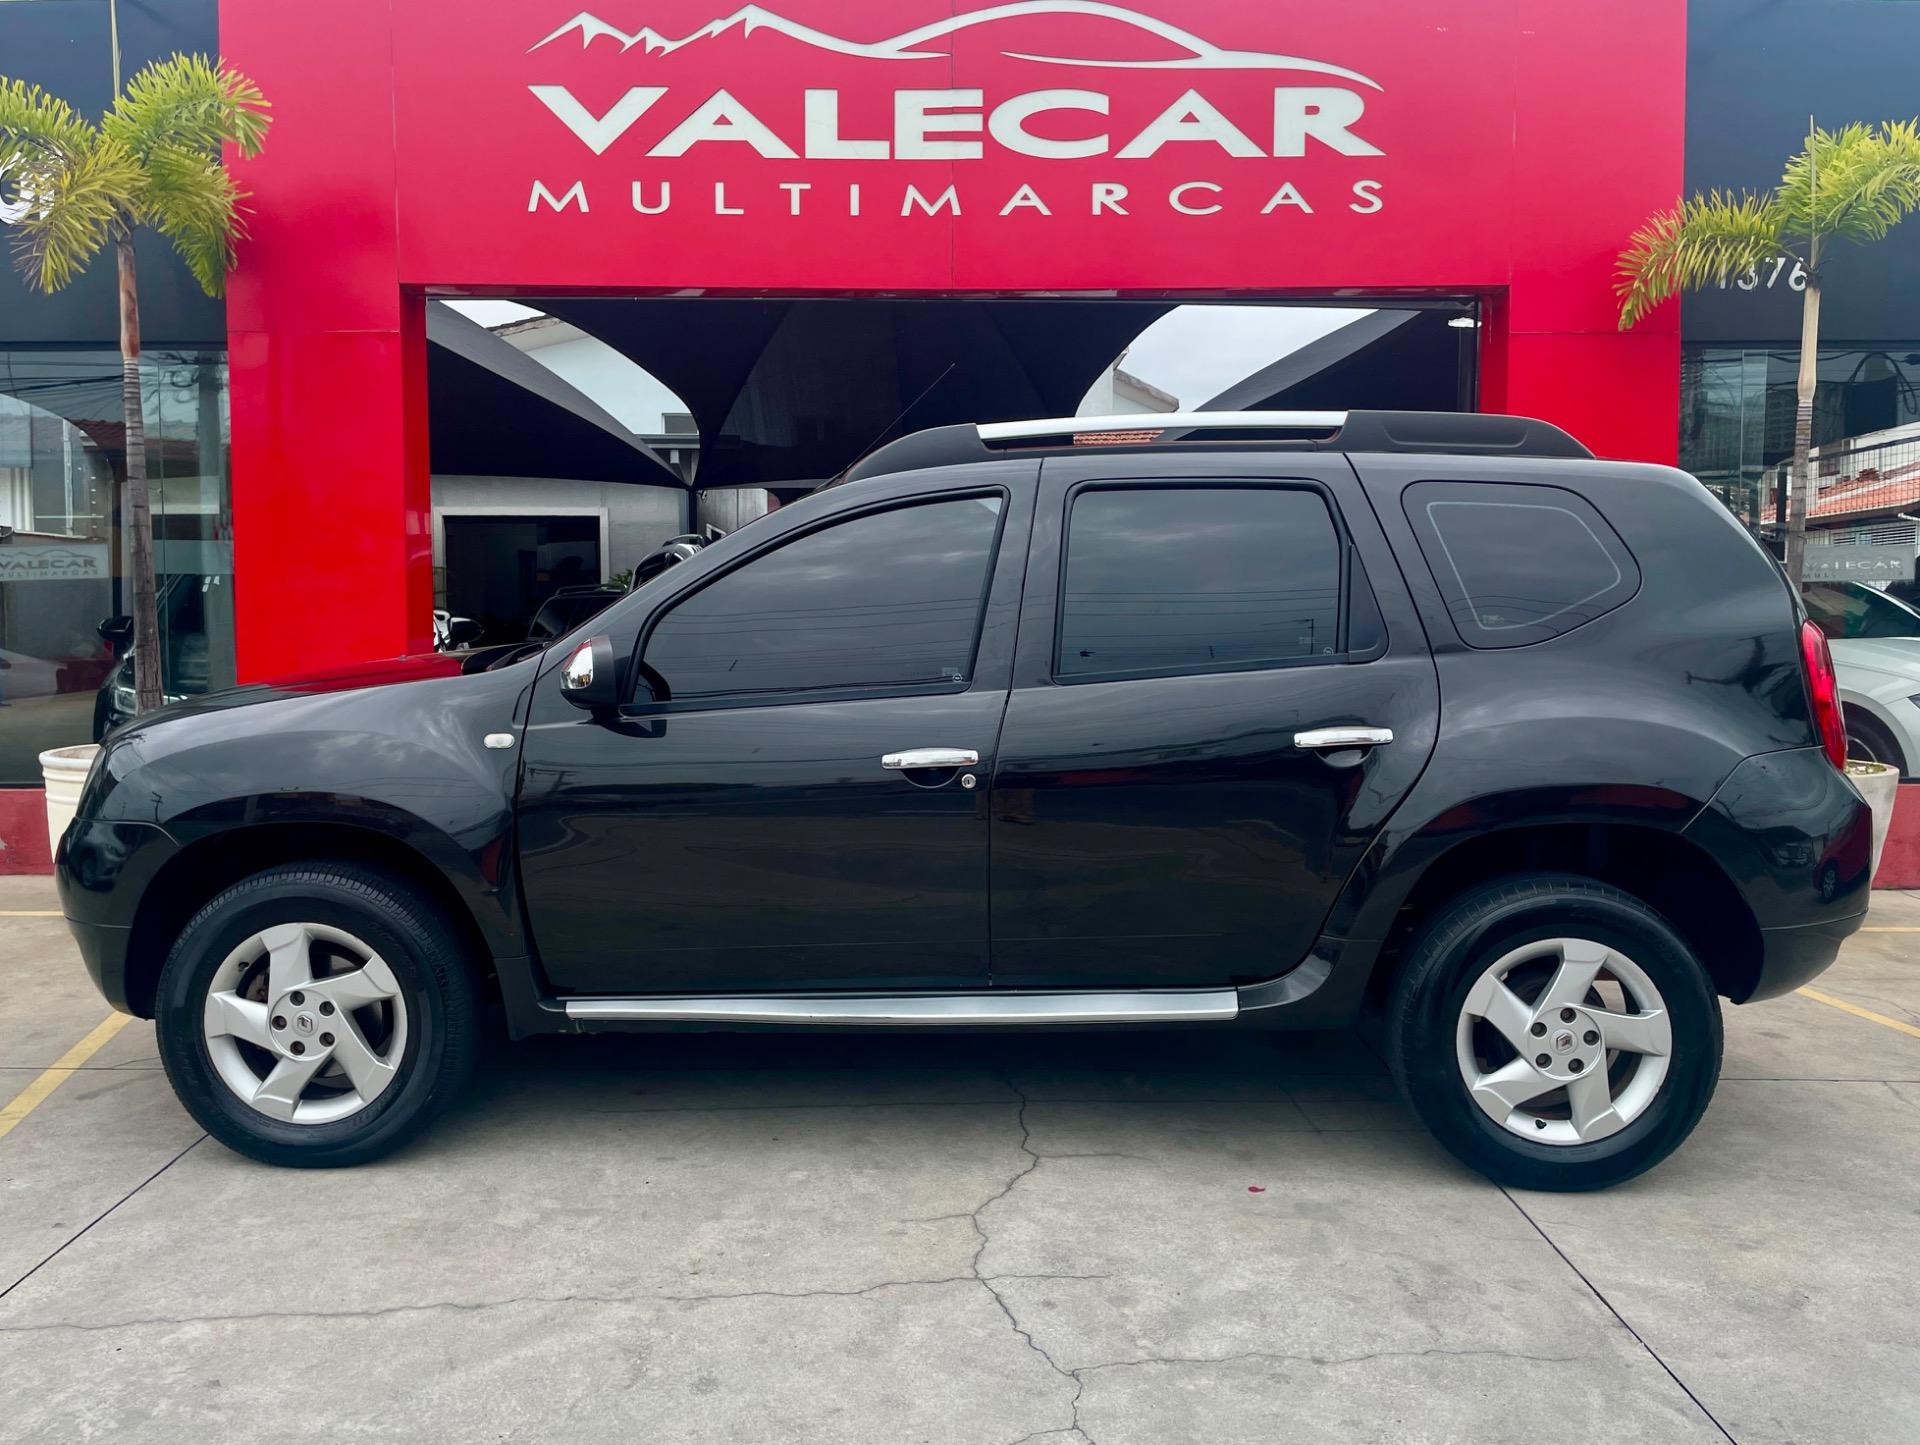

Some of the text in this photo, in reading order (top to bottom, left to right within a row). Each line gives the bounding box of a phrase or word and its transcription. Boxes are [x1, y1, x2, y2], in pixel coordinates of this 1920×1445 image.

[527, 84, 1387, 160] VALECAR
[527, 180, 1384, 217] MULTIMARCAS
[0, 559, 97, 570] VALECAR
